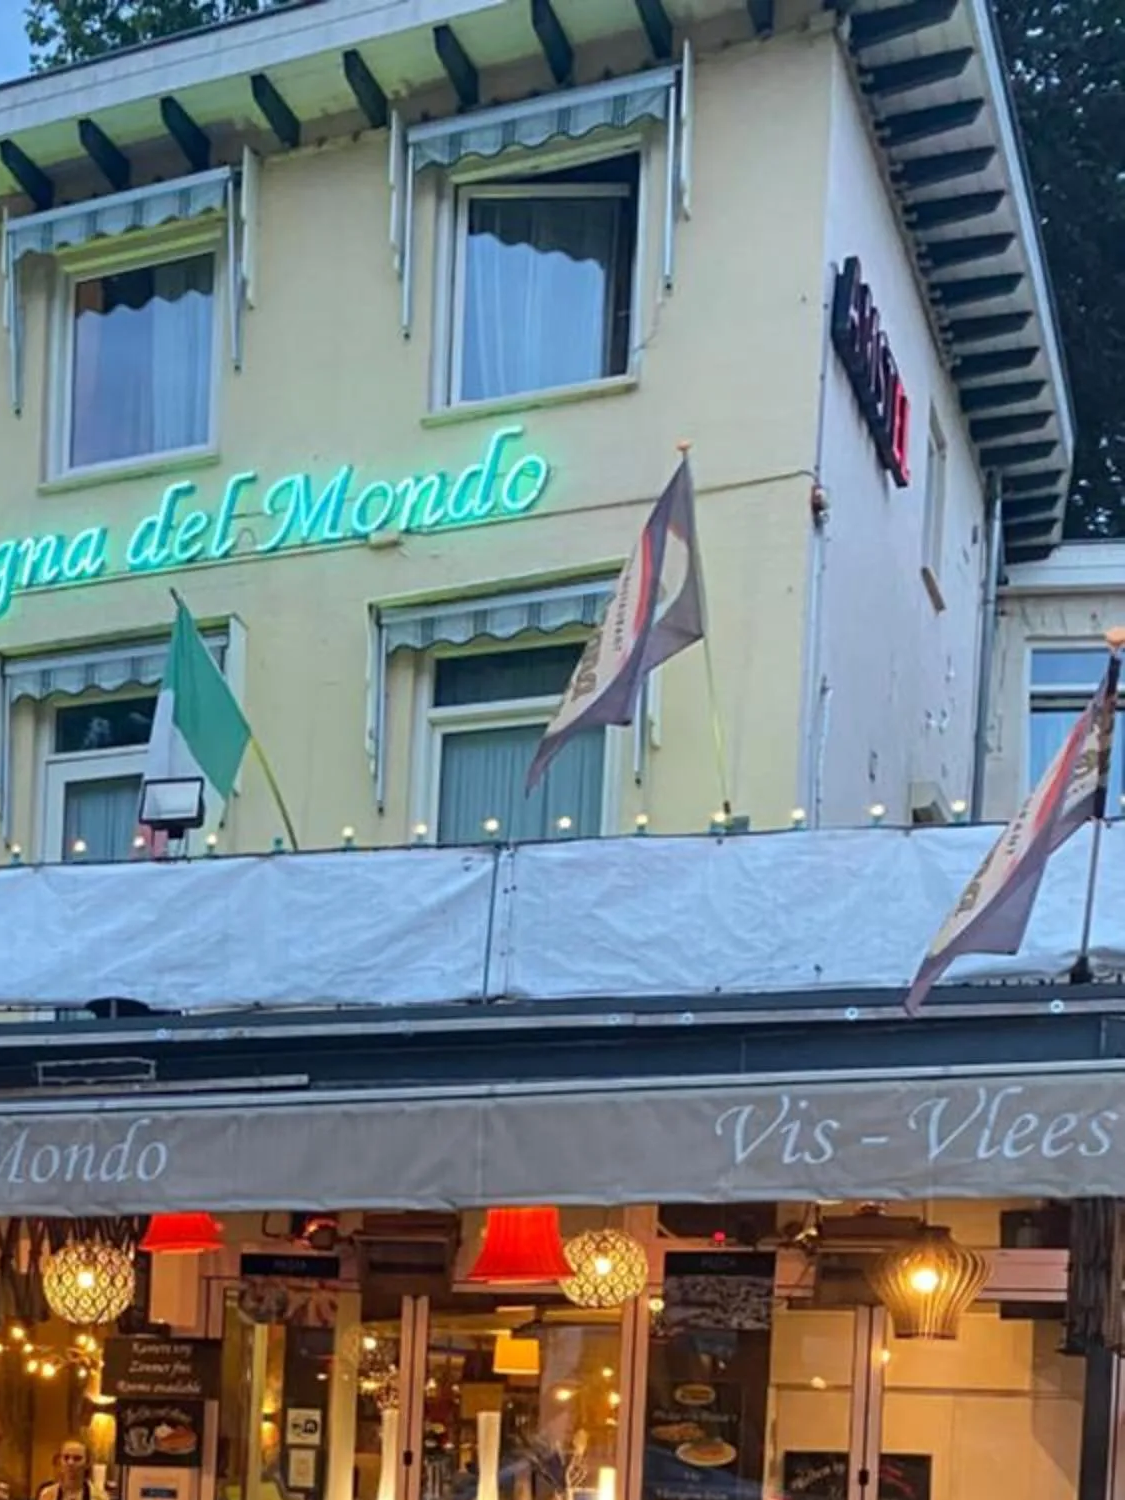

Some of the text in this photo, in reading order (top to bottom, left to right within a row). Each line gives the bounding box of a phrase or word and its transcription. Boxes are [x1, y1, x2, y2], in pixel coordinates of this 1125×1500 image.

[126, 471, 257, 570] del
[256, 424, 551, 553] Mondo
[714, 1093, 841, 1164] Vis
[907, 1085, 1120, 1160] Vlees
